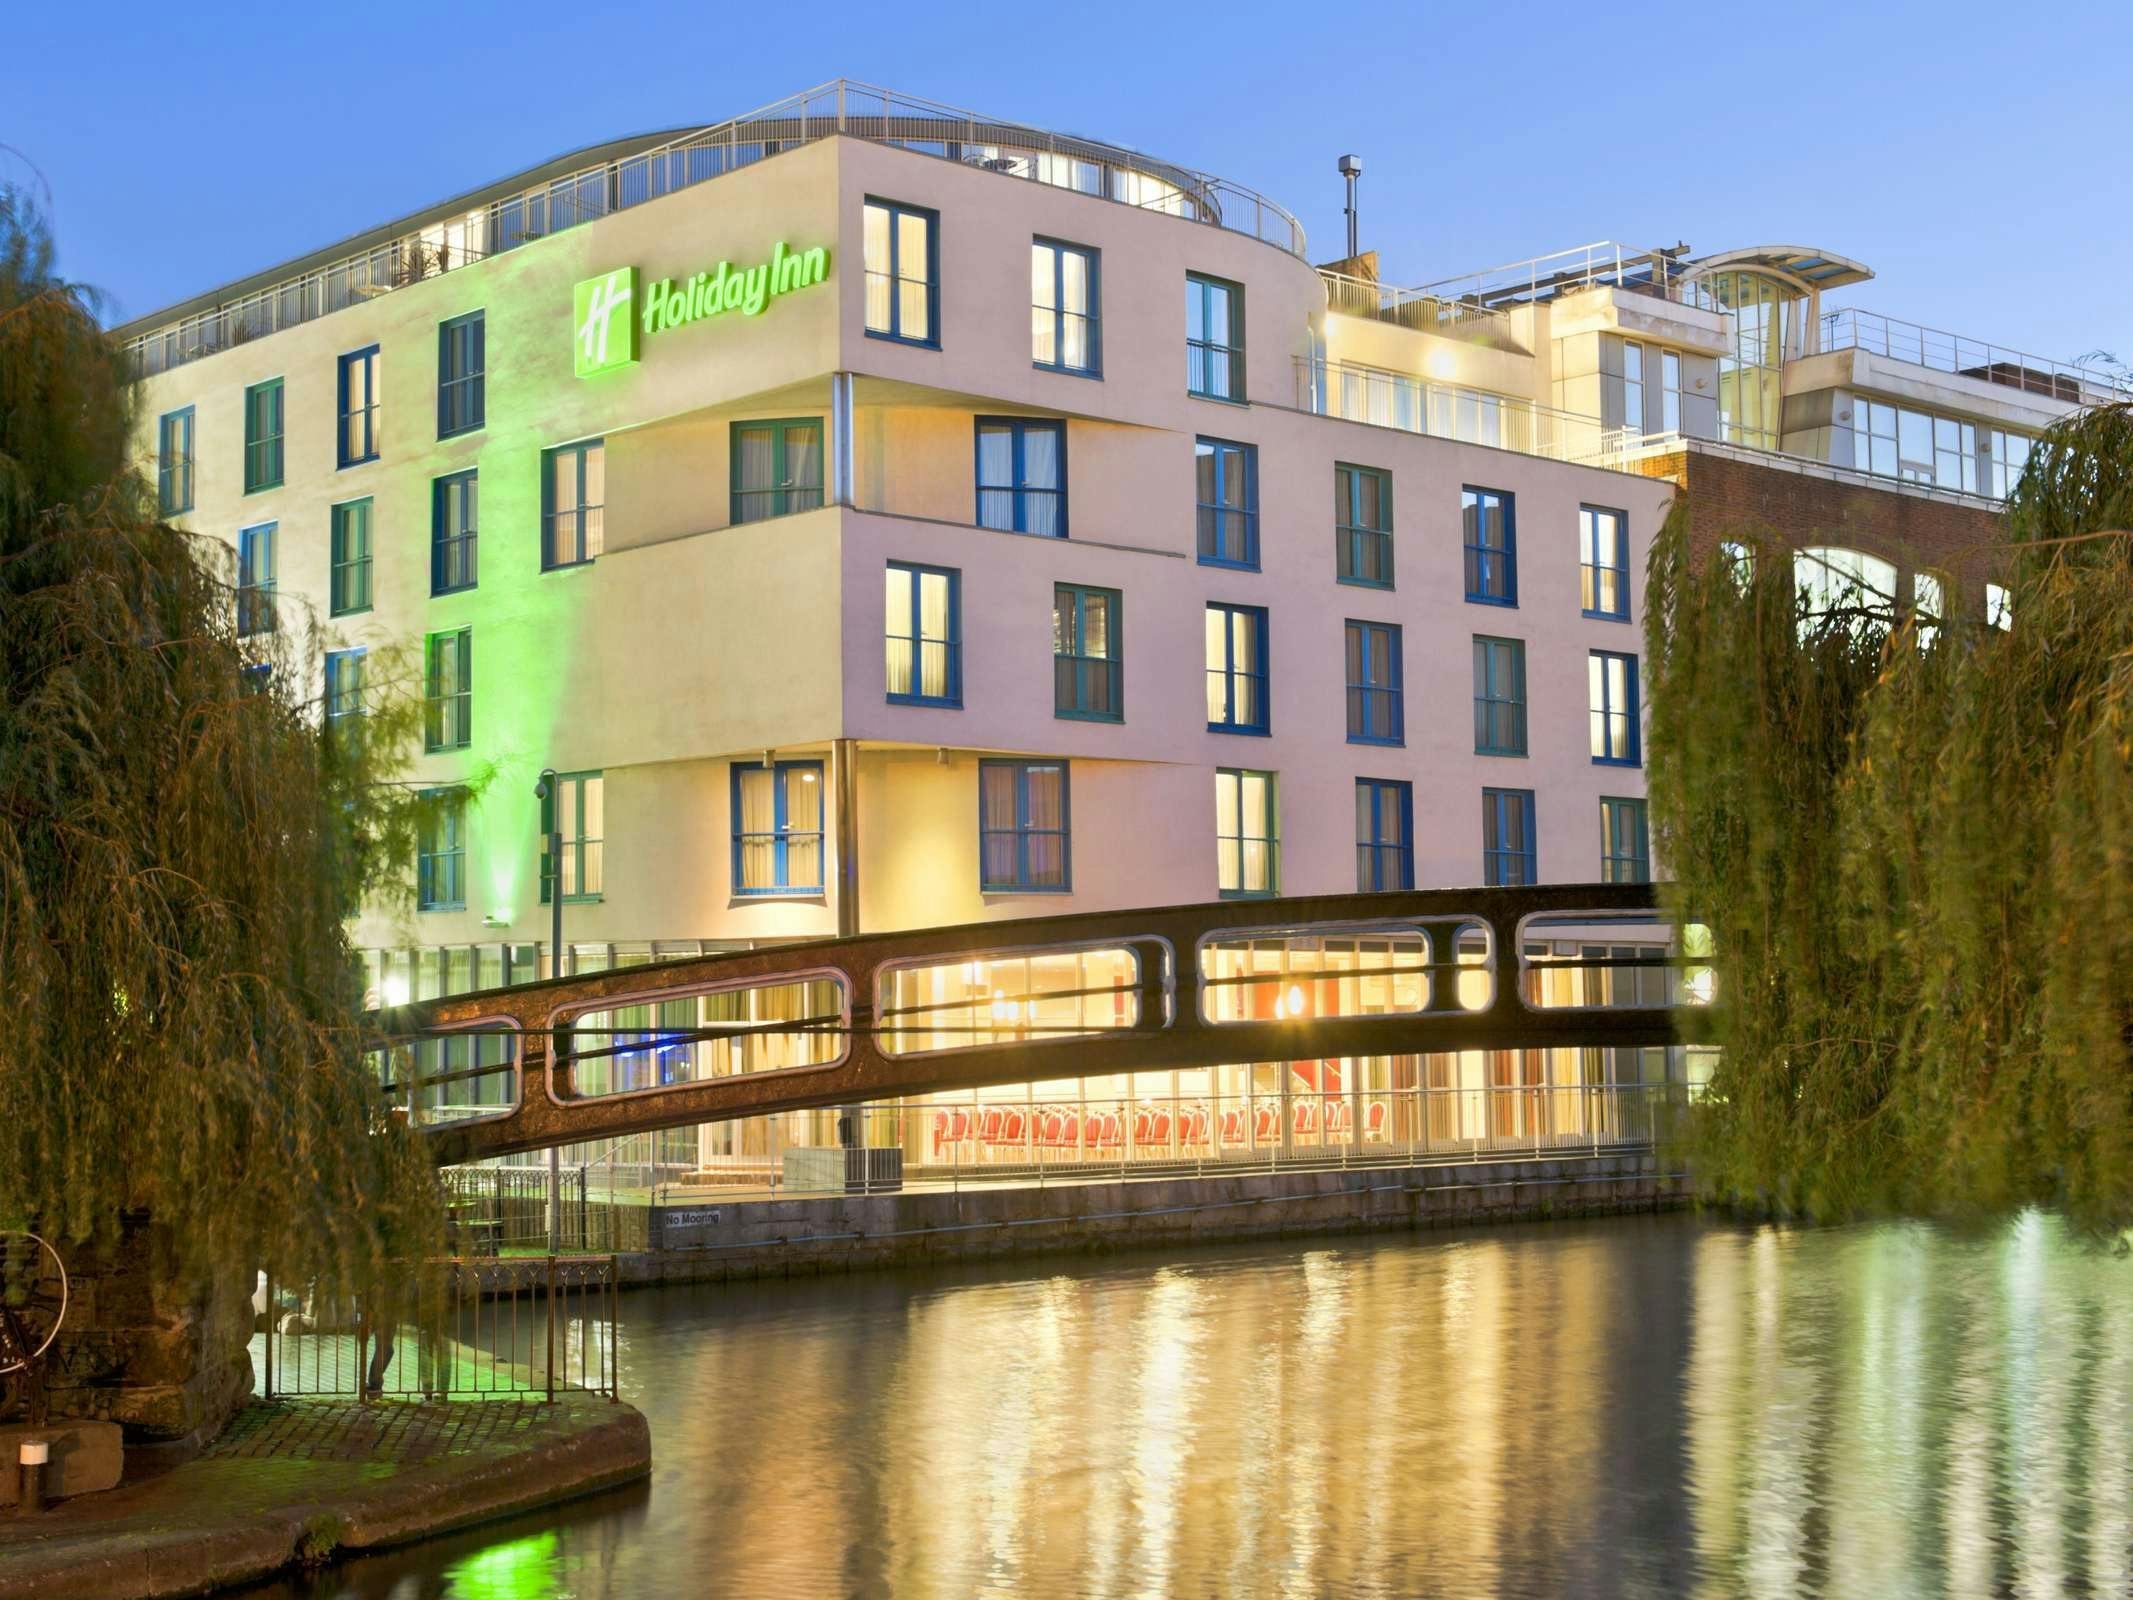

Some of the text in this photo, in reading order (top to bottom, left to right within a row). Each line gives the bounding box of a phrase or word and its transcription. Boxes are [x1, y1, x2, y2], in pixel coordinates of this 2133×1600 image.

[642, 240, 829, 333] Holiday Inn
[666, 1212, 720, 1225] No Mooring
